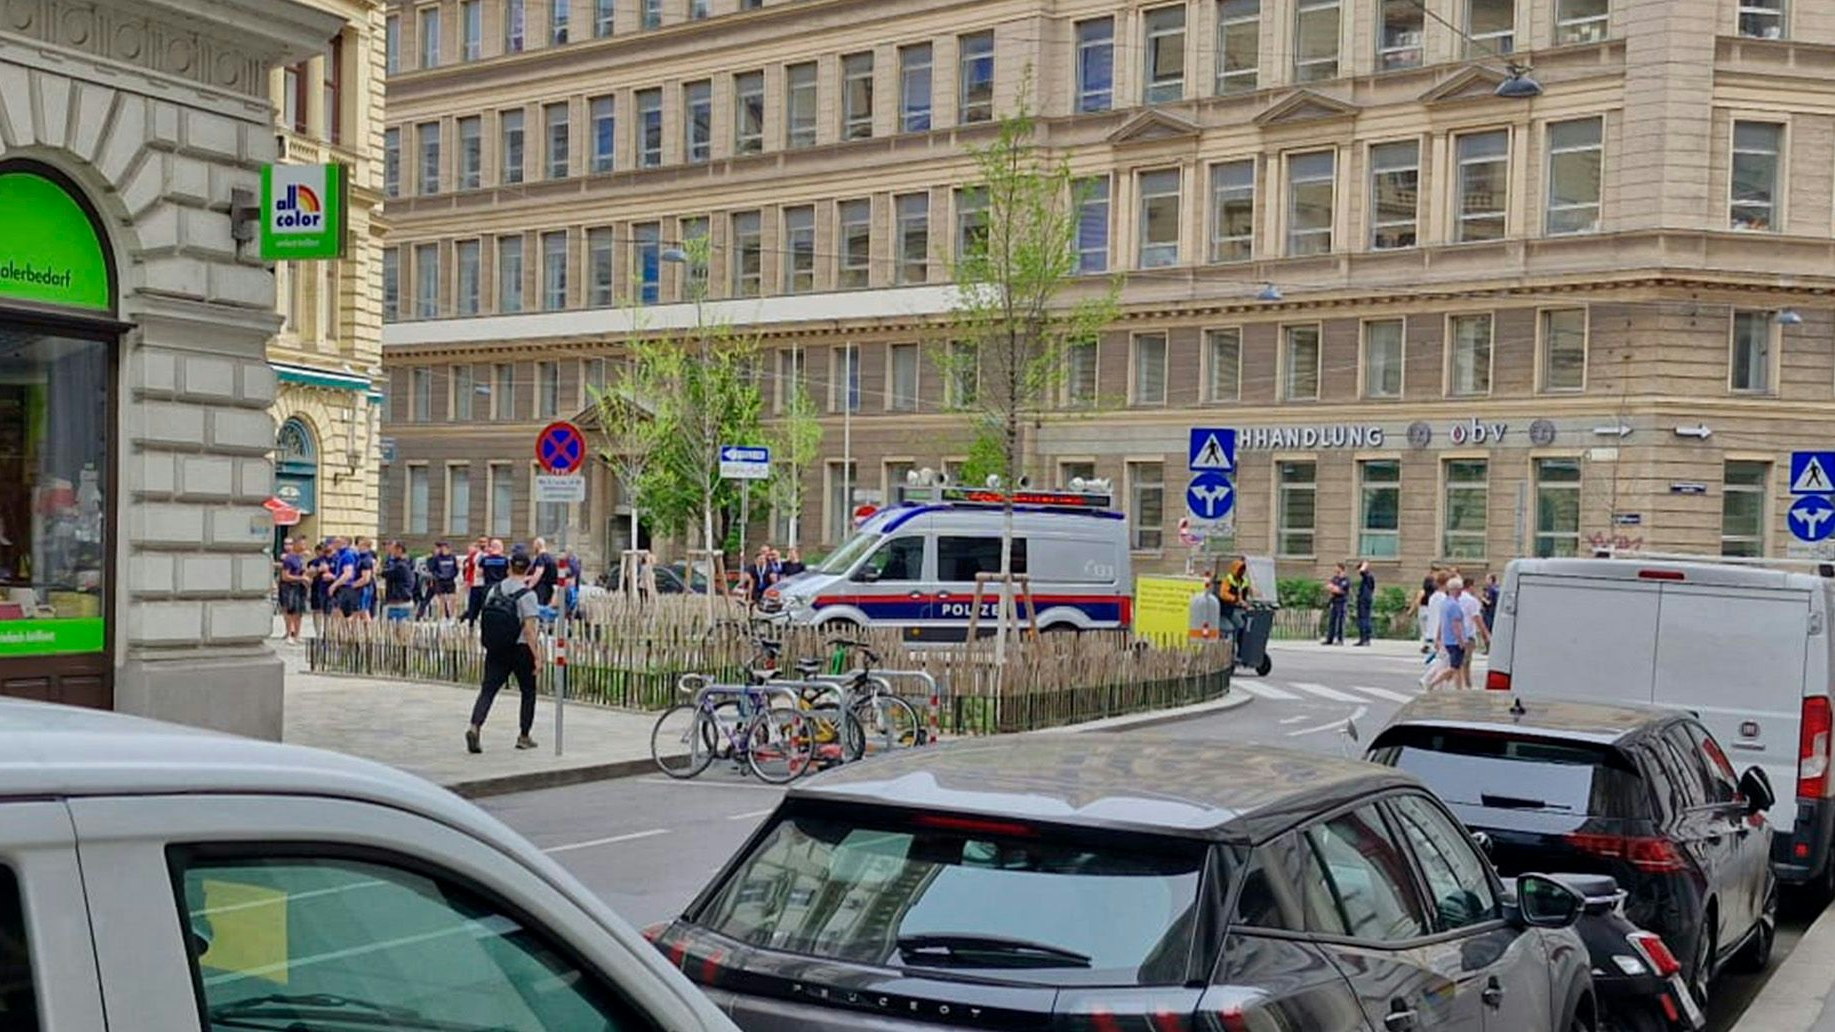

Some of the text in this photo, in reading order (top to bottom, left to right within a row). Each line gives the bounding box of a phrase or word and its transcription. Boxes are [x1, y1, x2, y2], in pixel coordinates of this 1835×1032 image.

[276, 184, 297, 210] all
[276, 210, 321, 227] color
[0, 259, 71, 289] alerbedarf
[1237, 425, 1385, 449] HHANDLUNG
[1450, 418, 1508, 445] obv
[941, 603, 999, 616] POLZE
